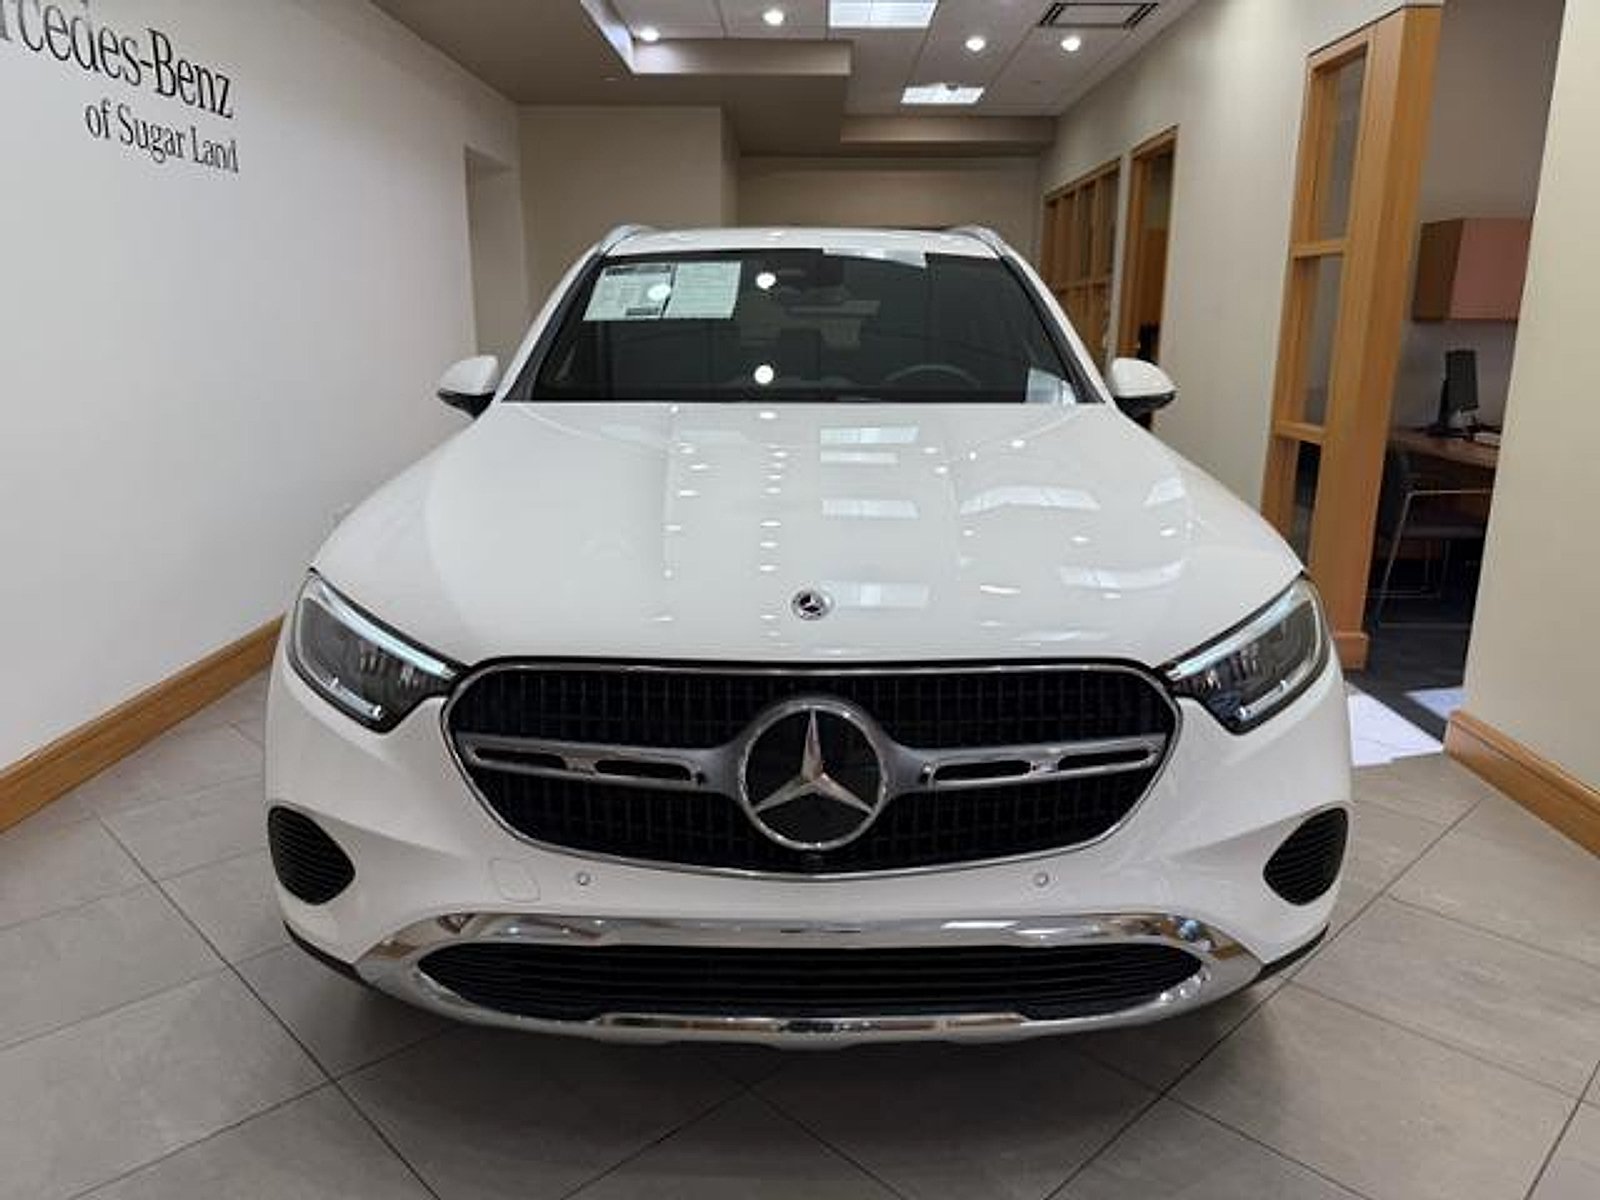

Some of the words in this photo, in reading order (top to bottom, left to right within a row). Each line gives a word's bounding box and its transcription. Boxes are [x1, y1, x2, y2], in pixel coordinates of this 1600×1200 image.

[85, 98, 111, 139] of
[118, 103, 185, 163] Sugar
[190, 125, 239, 173] Land
